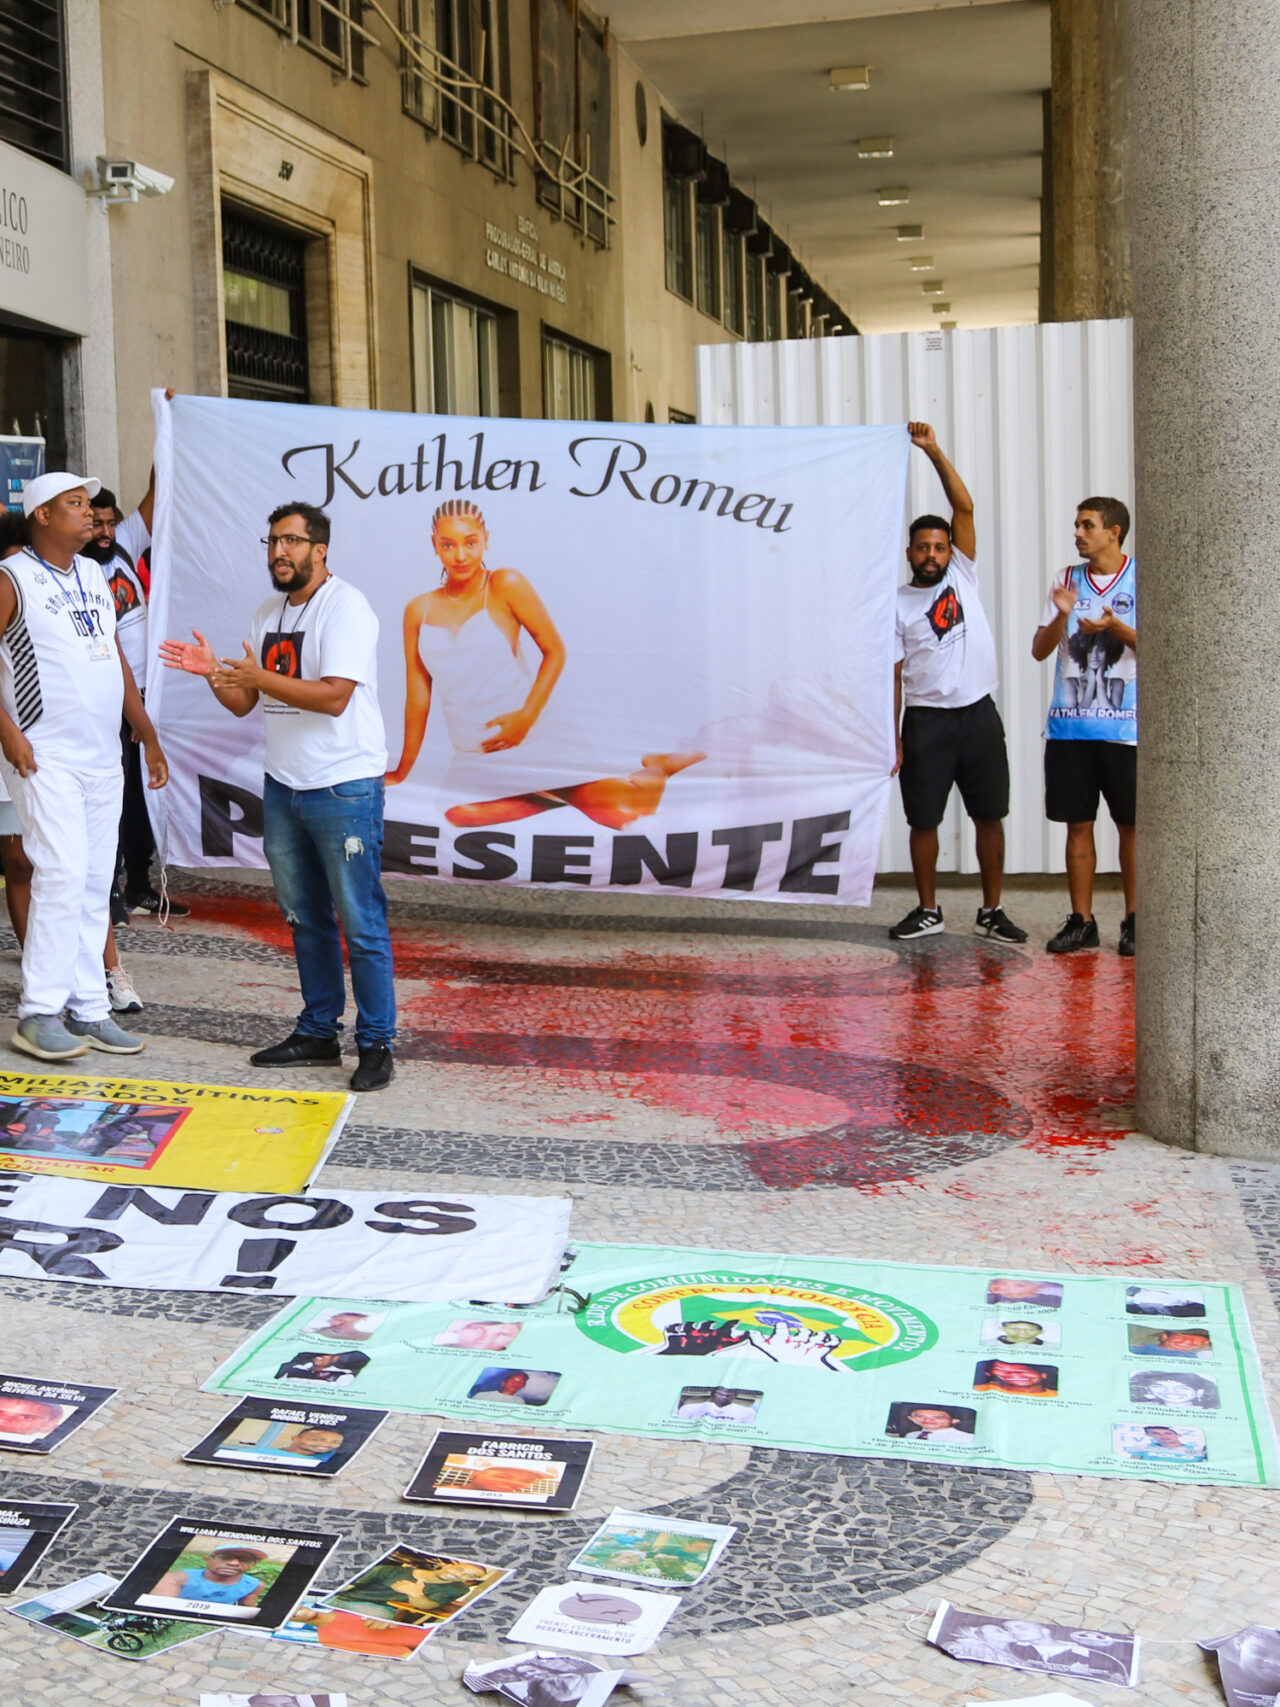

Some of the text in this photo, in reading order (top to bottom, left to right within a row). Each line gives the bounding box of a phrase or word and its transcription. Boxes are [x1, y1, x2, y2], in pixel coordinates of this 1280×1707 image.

[281, 432, 796, 534] Kathlen Romeu
[197, 774, 853, 898] PESENTE
[24, 1085, 191, 1105] ESTADOS
[171, 1086, 322, 1107] VÍTIMAS
[23, 1158, 117, 1174] MILITAR
[86, 1185, 479, 1236] NOS
[625, 1274, 829, 1293] COMUNIDADES
[835, 1286, 855, 1297] E
[632, 1286, 727, 1310] CONTRA
[739, 1287, 756, 1295] A
[1, 1386, 44, 1398] OLIVEIRA
[43, 1391, 57, 1399] DA
[57, 1392, 88, 1403] SILVA
[2, 1380, 39, 1391] MICHEL
[270, 1414, 339, 1427] MOURA ALVES
[271, 1407, 307, 1418] RAFAEL
[467, 1446, 554, 1461] DOS SANTOS
[481, 1440, 545, 1453] FABRICIO
[179, 1526, 217, 1538] WILLIAM
[267, 1537, 286, 1546] DOS
[285, 1538, 323, 1549] SANTOS
[536, 1624, 632, 1644] DESENCARCERAMENTO
[539, 1618, 636, 1639] FRENTE ESTADUAL PELO
